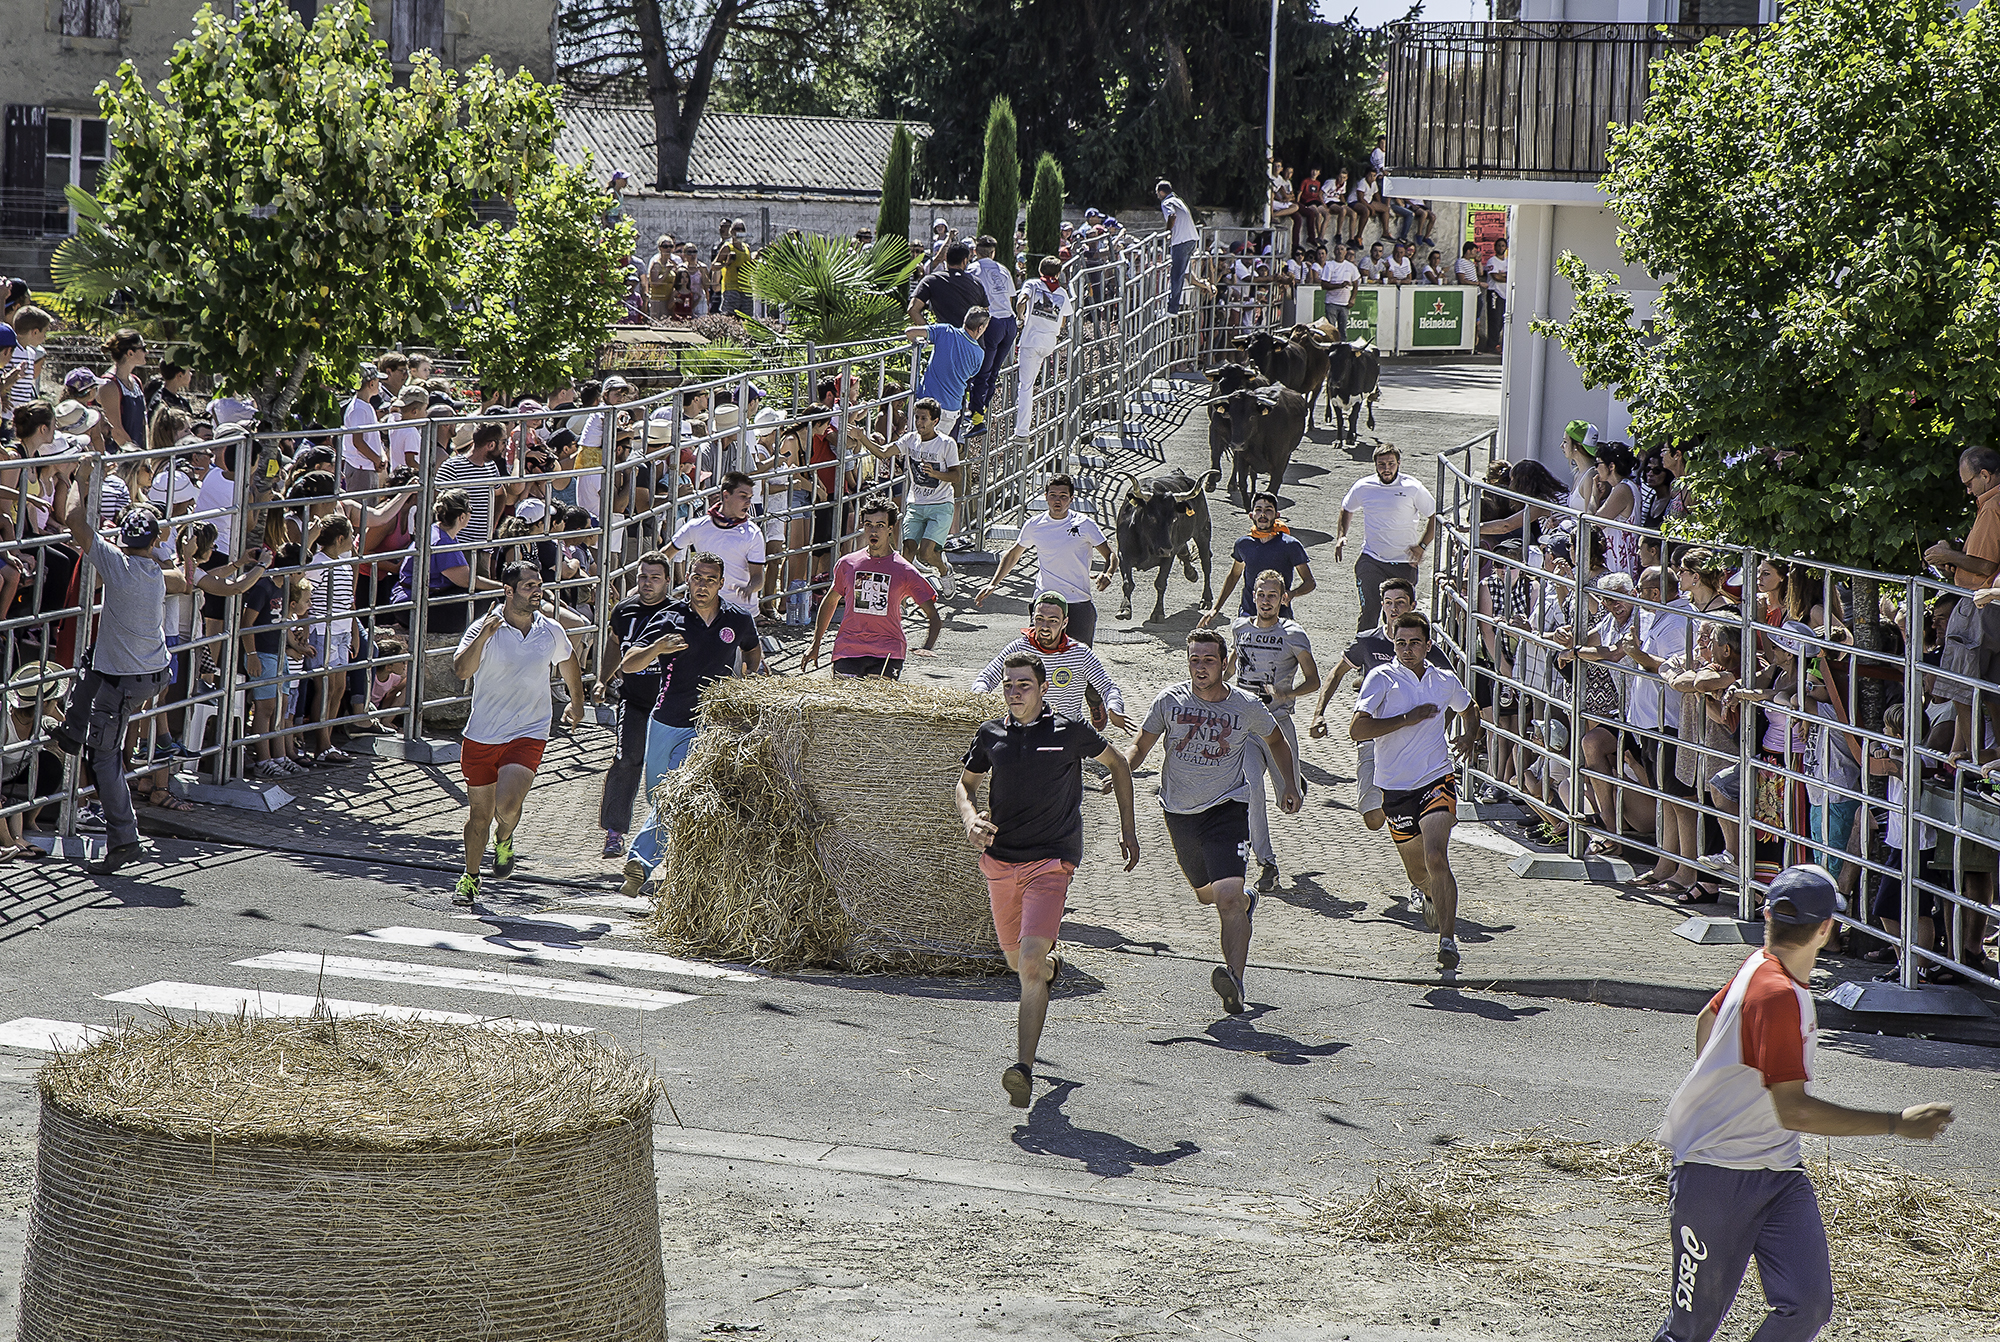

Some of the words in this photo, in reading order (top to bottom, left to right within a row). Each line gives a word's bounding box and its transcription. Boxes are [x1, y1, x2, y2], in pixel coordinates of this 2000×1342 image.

[1346, 317, 1369, 329] eken
[1419, 317, 1457, 330] Heineken
[1255, 634, 1283, 645] CUBA
[1171, 706, 1242, 731] PETROL
[1175, 751, 1222, 767] QUALITY
[1675, 1252, 1699, 1313] asics
